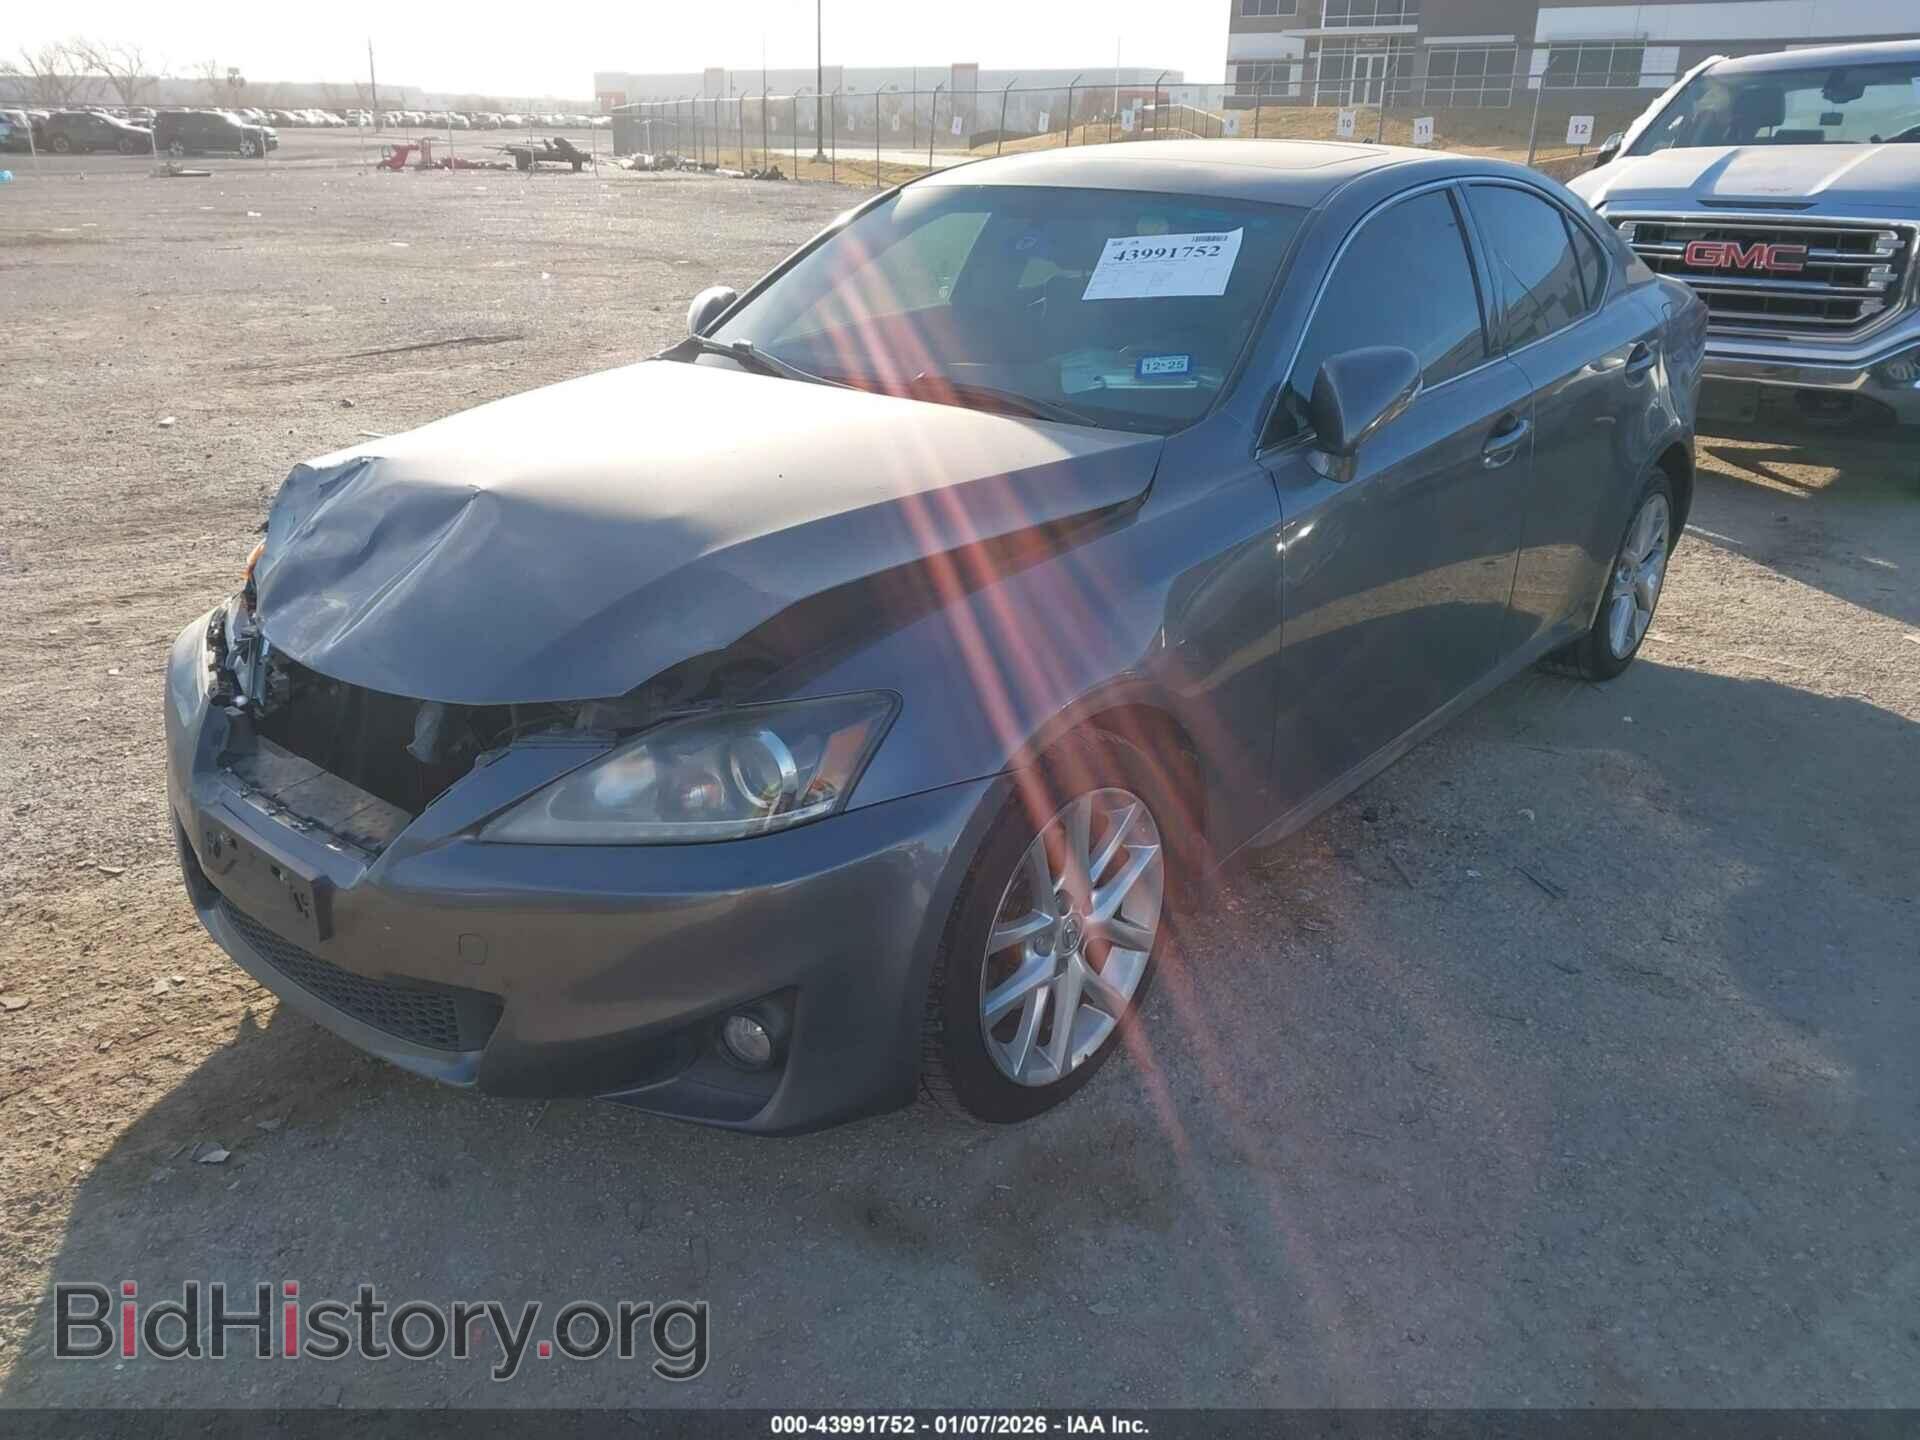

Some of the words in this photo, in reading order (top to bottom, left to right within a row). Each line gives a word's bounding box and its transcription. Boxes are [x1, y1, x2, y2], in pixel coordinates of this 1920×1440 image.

[1341, 119, 1352, 128] 10
[1418, 125, 1429, 135] 11
[1574, 124, 1588, 134] 12
[1112, 245, 1221, 261] 43991752
[1685, 240, 1807, 271] GMC
